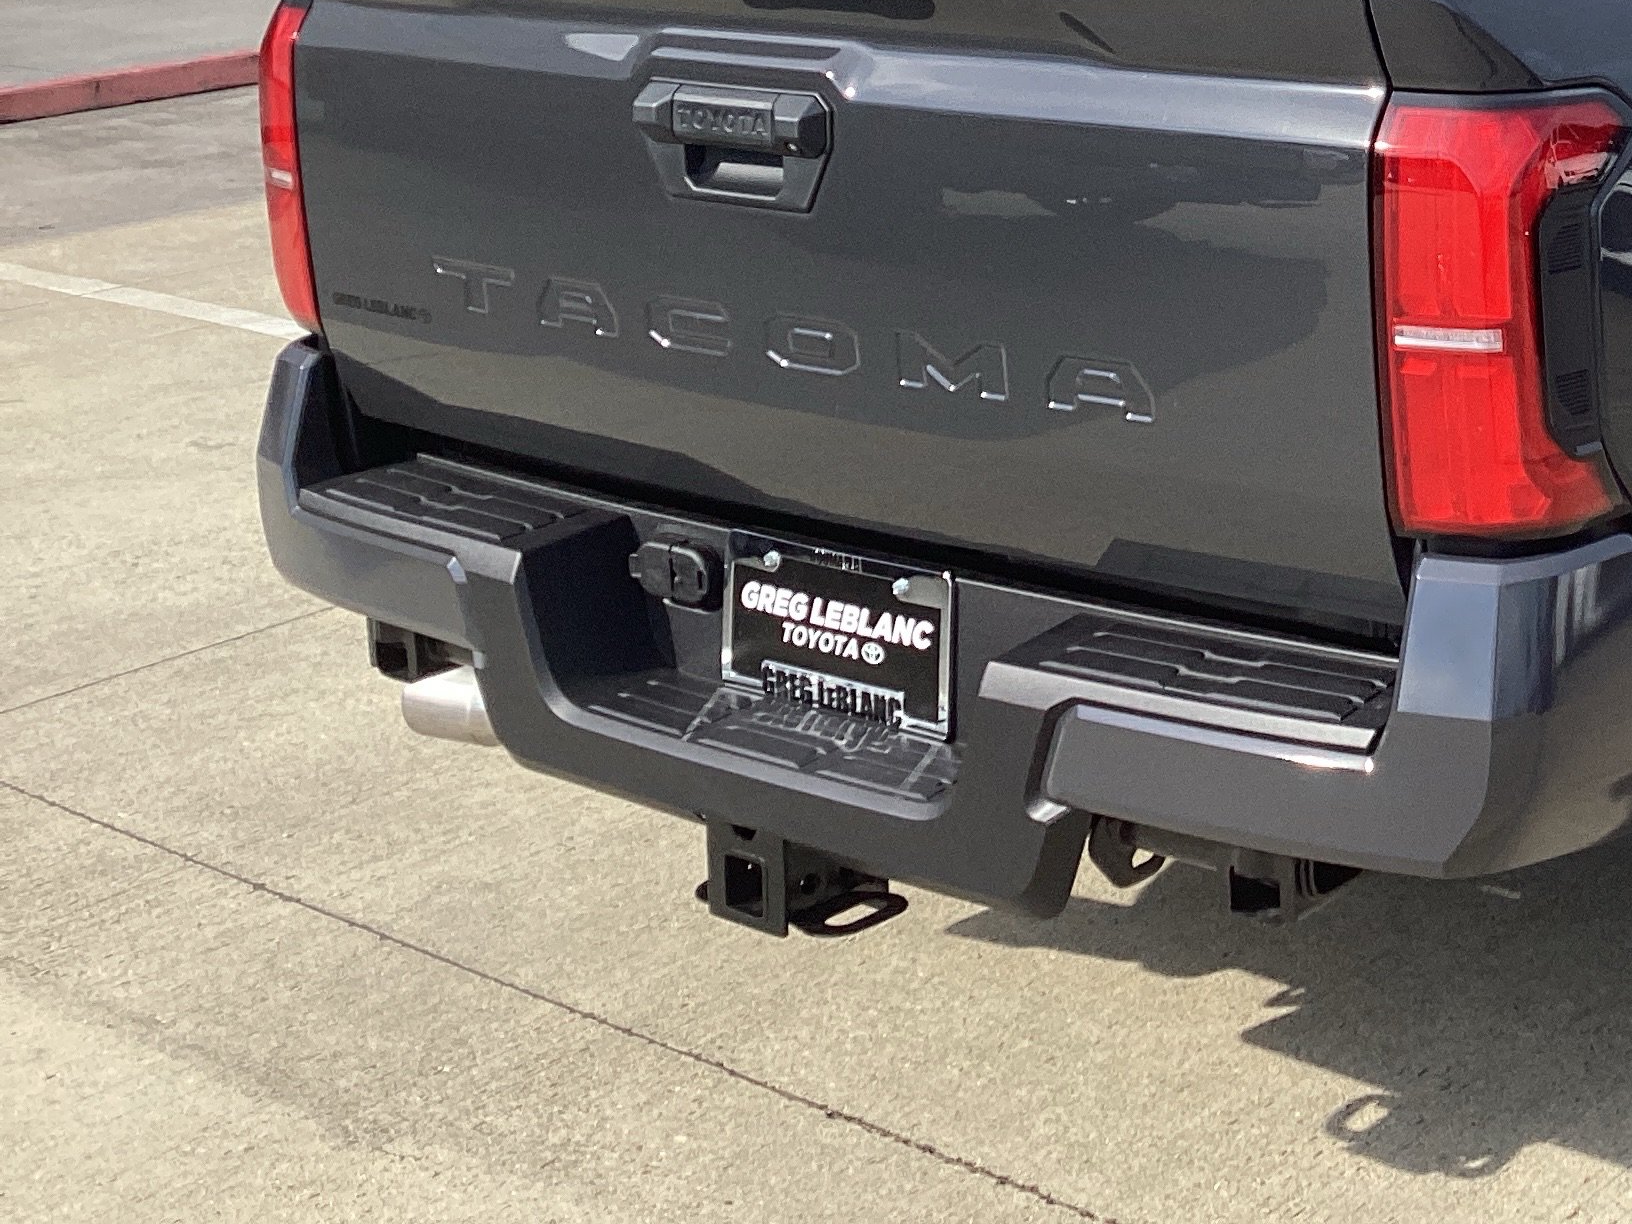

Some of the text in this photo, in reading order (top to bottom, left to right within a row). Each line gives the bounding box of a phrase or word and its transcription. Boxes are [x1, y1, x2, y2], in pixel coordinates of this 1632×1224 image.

[676, 107, 768, 135] TOYOTA
[431, 255, 1156, 423] TACOMA
[740, 580, 935, 650] GREG LEBLANC
[781, 621, 860, 661] TOYOTA
